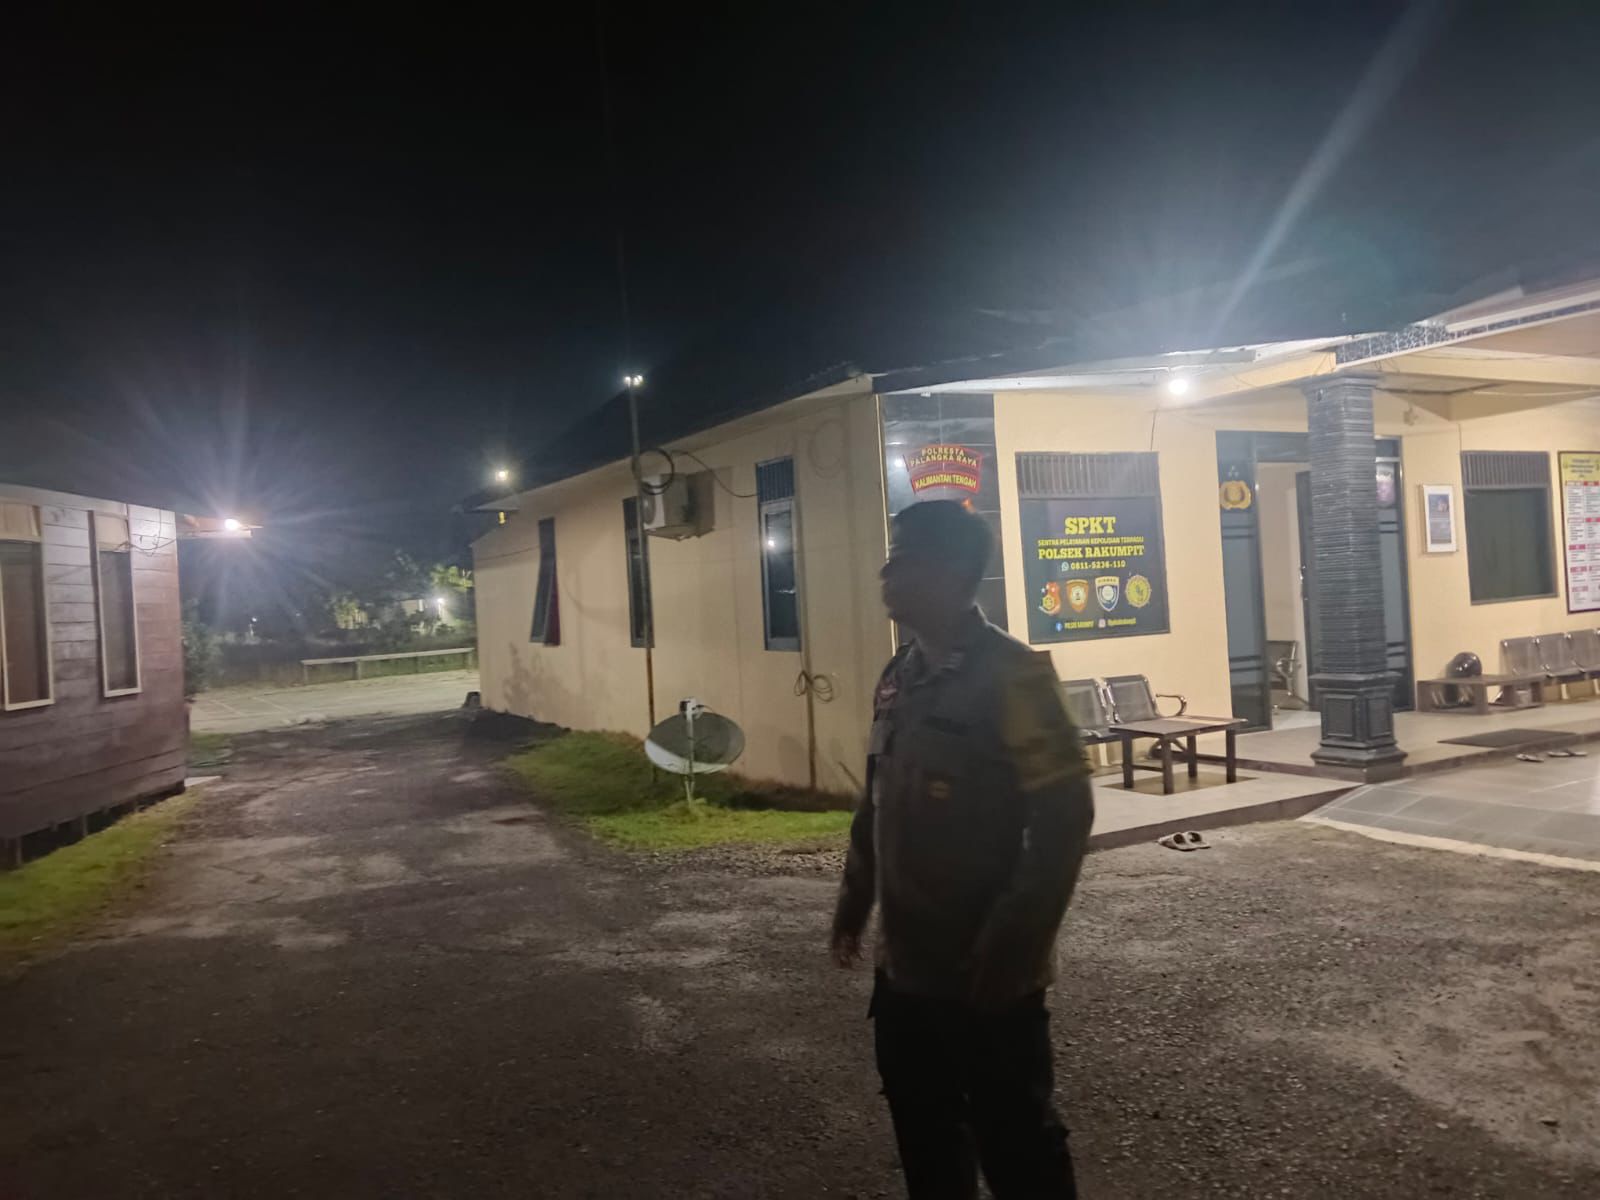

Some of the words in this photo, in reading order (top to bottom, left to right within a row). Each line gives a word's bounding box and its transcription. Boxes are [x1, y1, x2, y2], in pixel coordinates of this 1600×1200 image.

[921, 447, 964, 456] POLRESTA
[910, 454, 954, 466] PALANGKA
[956, 455, 977, 467] RAYA
[915, 473, 952, 488] KALIMANTAN
[952, 474, 977, 488] TENGAH
[1064, 516, 1116, 534] SPKT
[1038, 547, 1083, 560] POLSEK
[1085, 545, 1145, 559] RAKUMPIT
